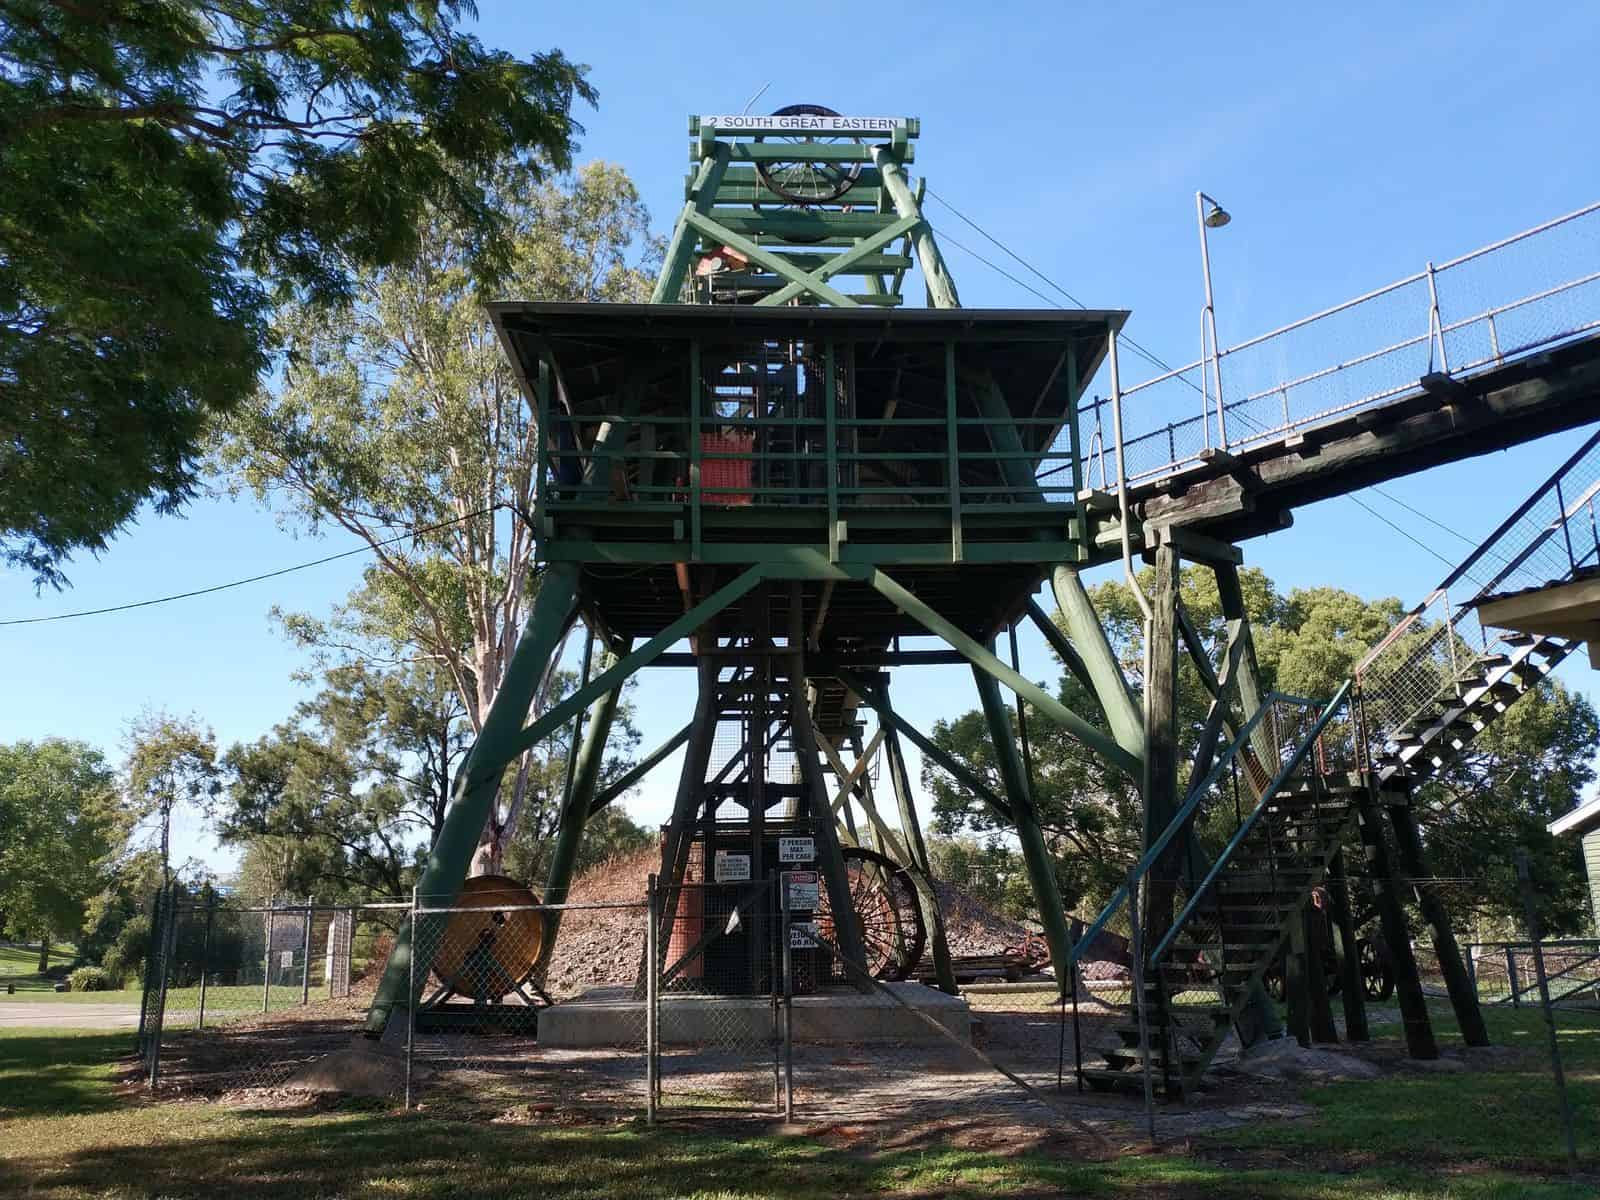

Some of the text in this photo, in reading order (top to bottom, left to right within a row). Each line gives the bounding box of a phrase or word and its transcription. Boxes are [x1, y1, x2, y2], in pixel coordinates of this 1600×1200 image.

[709, 116, 899, 129] 2 SOUTH GREAT EASTERN
